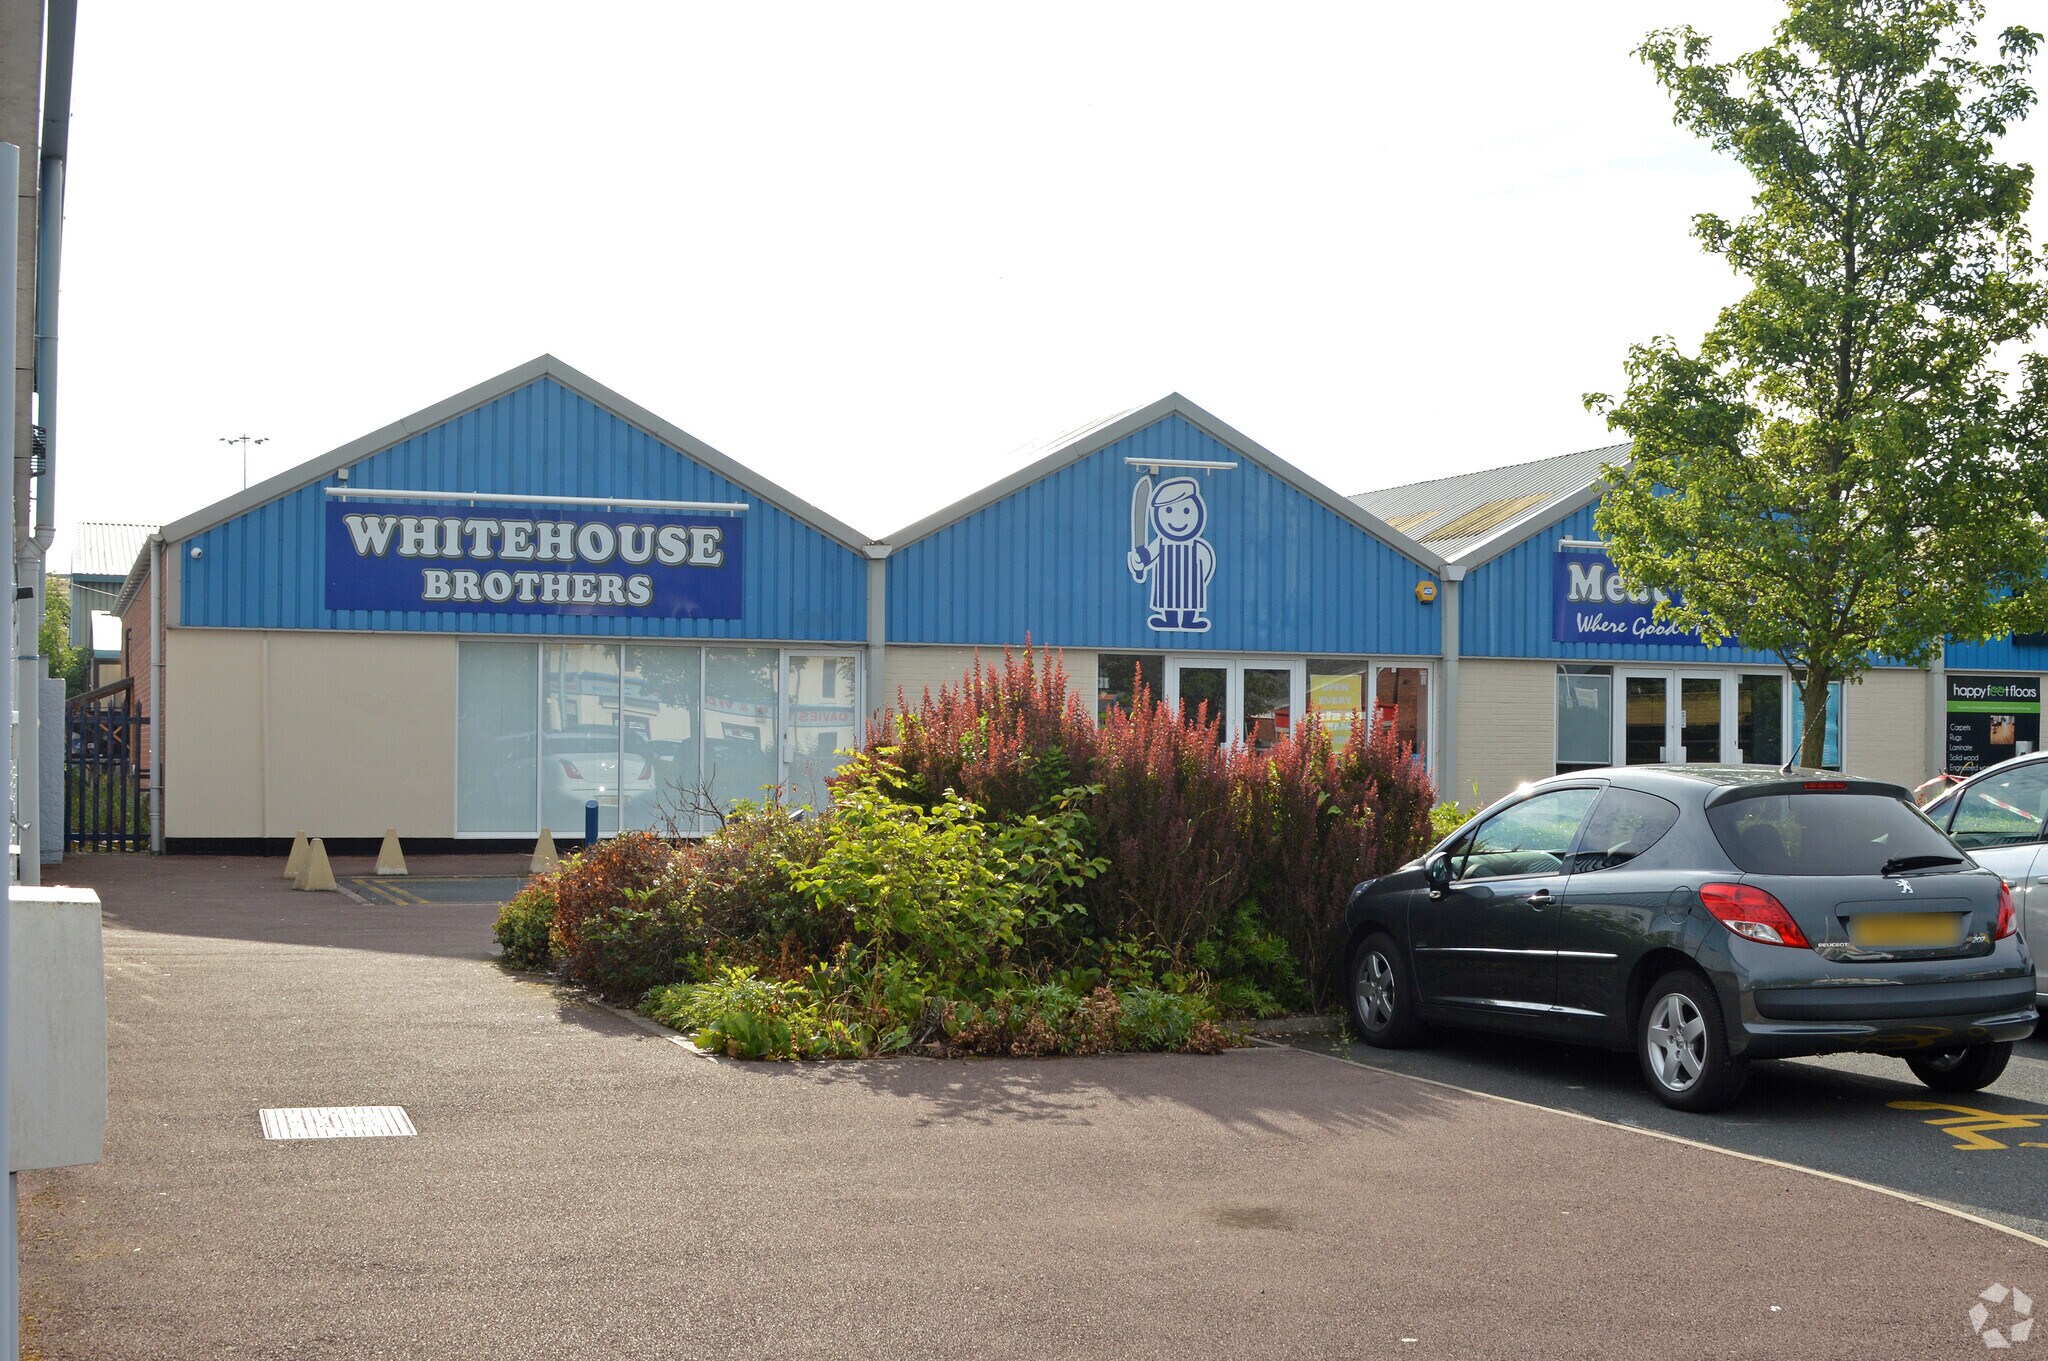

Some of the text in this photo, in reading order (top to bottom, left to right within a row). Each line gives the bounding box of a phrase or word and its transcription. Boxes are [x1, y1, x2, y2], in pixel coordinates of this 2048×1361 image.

[343, 514, 724, 568] WHITEHOUSE
[422, 568, 653, 605] BROTHERS
[1576, 612, 1628, 634] Where
[1632, 616, 1679, 640] Good
[1321, 683, 1349, 692] OPEN
[1953, 683, 2037, 699] happy feet floors
[1319, 696, 1352, 704] EVERY
[1950, 723, 1971, 732] Carpets
[1950, 733, 1963, 742] Rugs
[1950, 753, 1963, 761] Solid
[1971, 936, 1986, 944] 207
